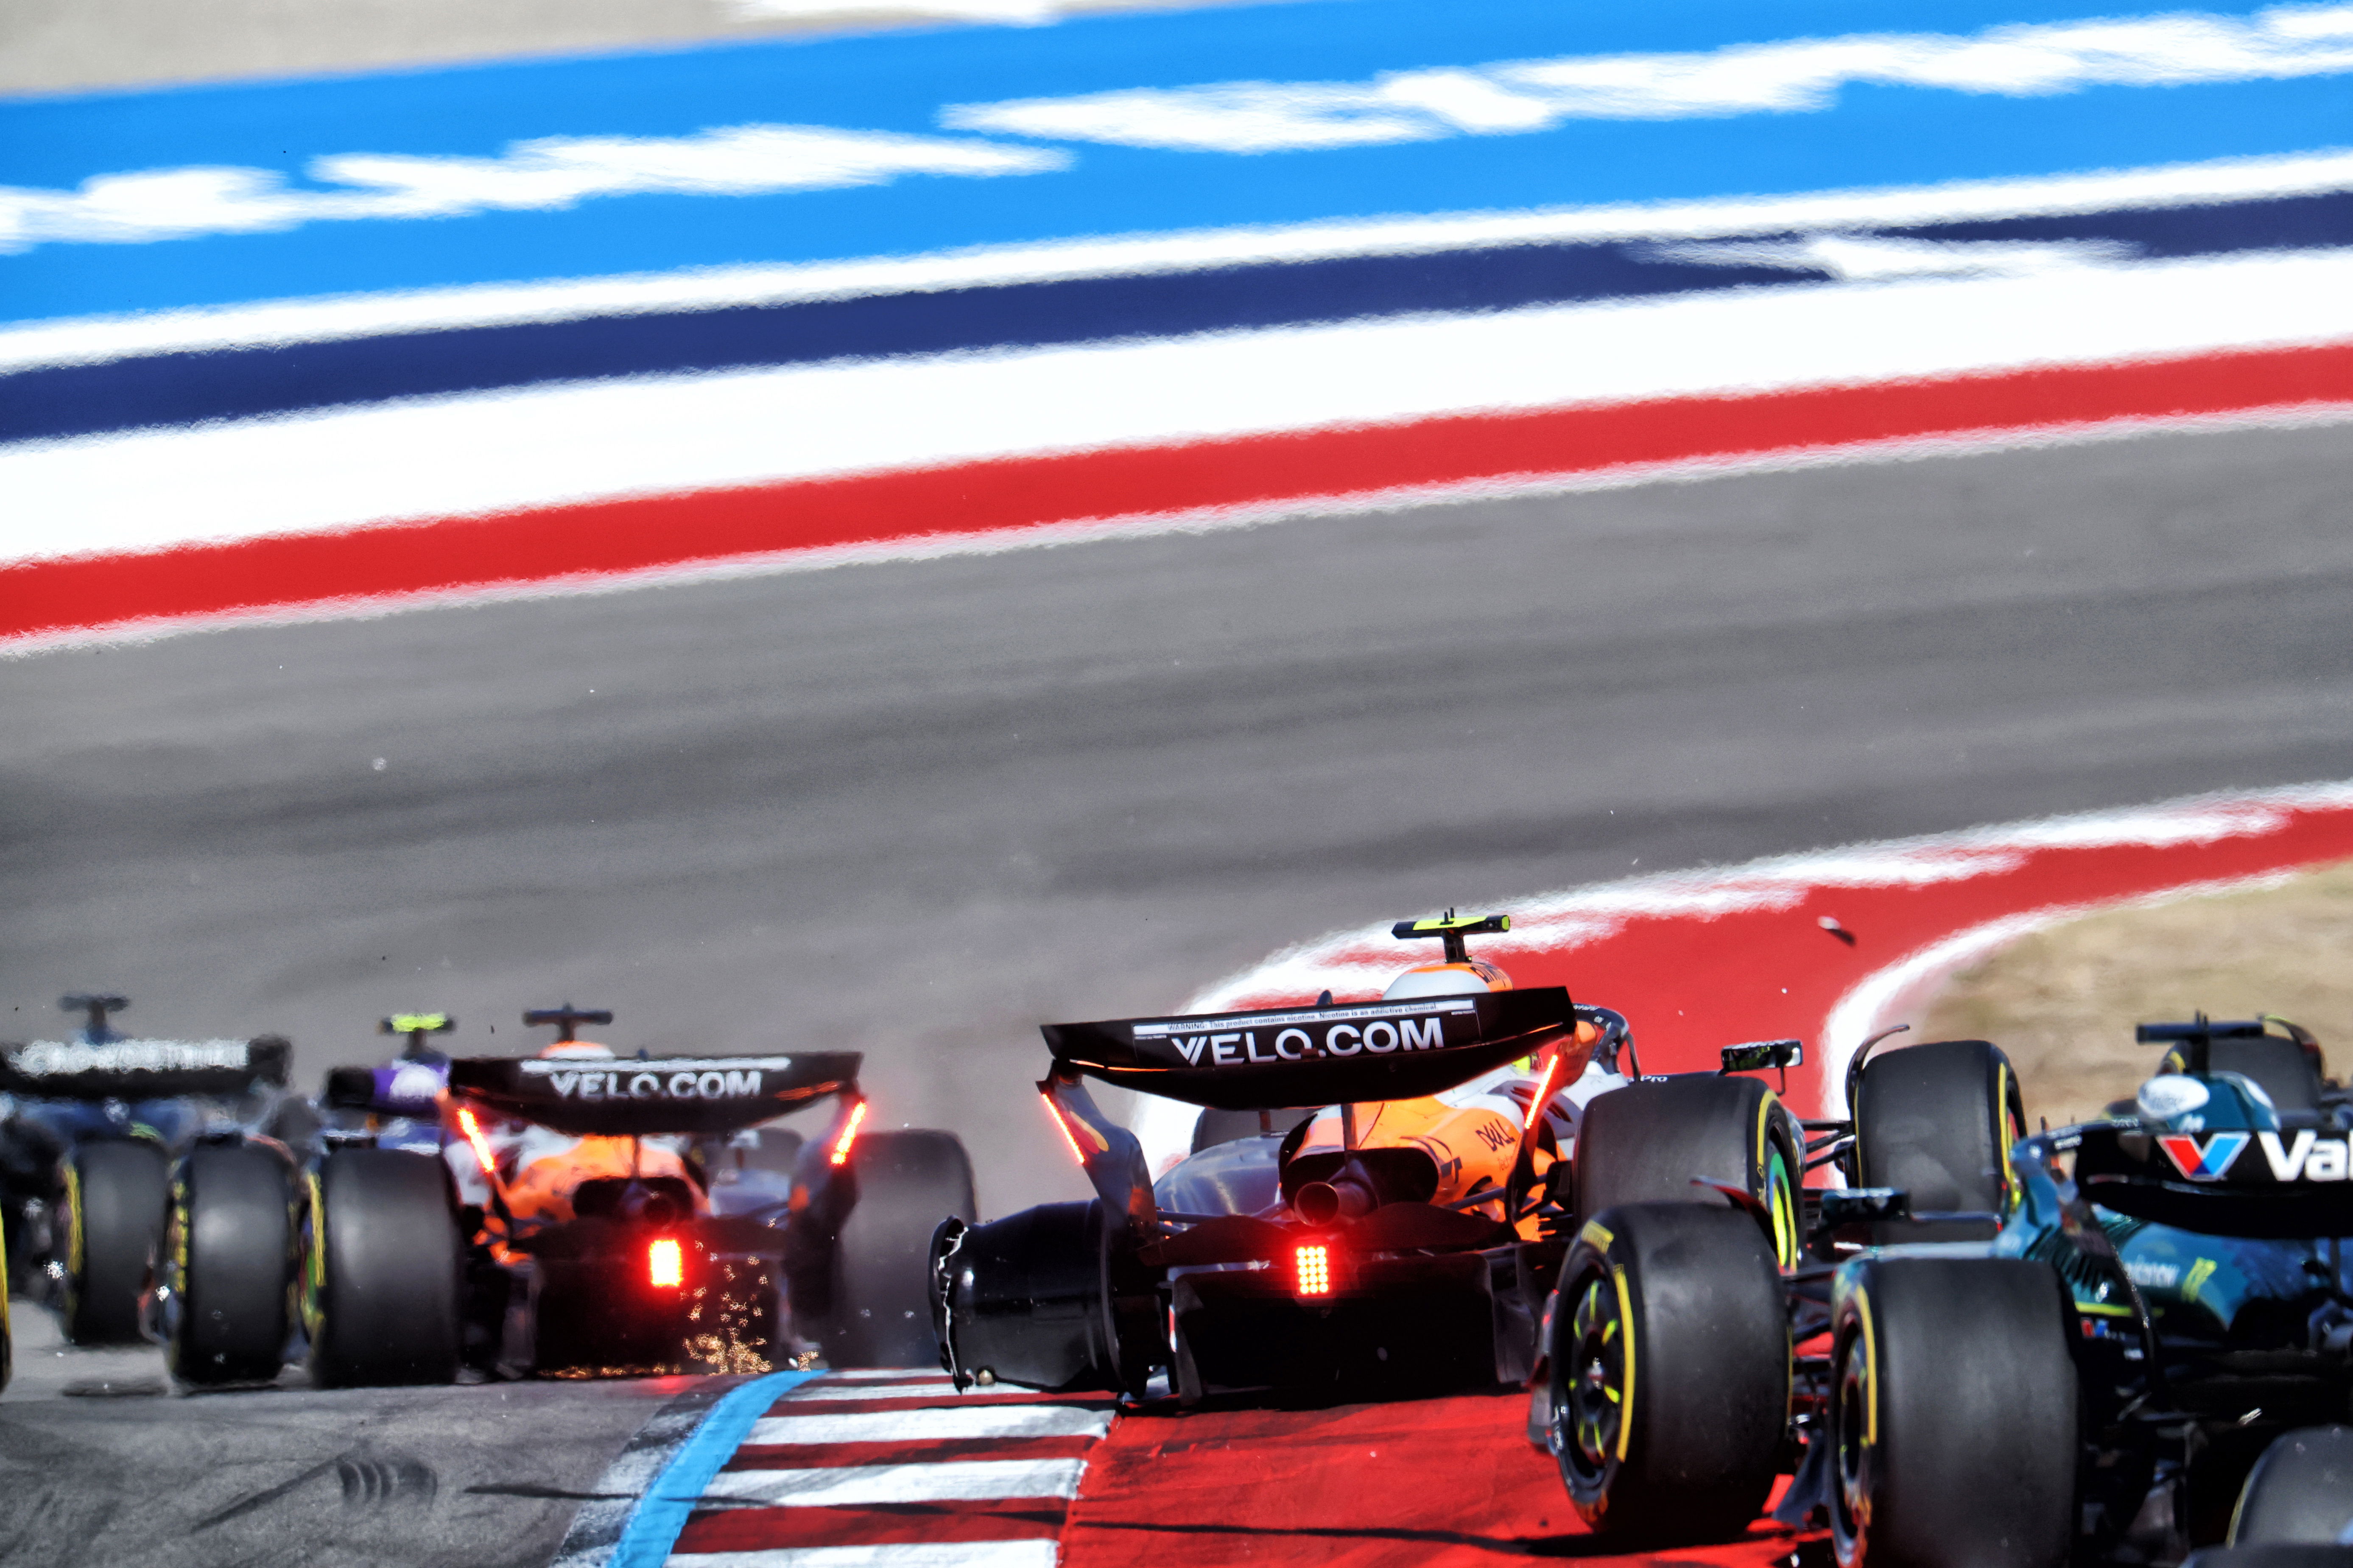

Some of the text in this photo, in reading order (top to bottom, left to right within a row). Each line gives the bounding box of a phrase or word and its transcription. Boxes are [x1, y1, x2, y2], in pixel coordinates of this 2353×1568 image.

[1168, 1022, 1207, 1032] WARNING:
[1209, 1020, 1224, 1028] This
[1226, 1017, 1253, 1029] product
[1254, 1015, 1285, 1024] contains
[1287, 1013, 1317, 1021] nicotine.
[1319, 1010, 1349, 1018] Nicotine
[1371, 1006, 1403, 1015] addictive
[1171, 1017, 1445, 1067] VELO.COM
[2257, 1128, 2353, 1181] Va
